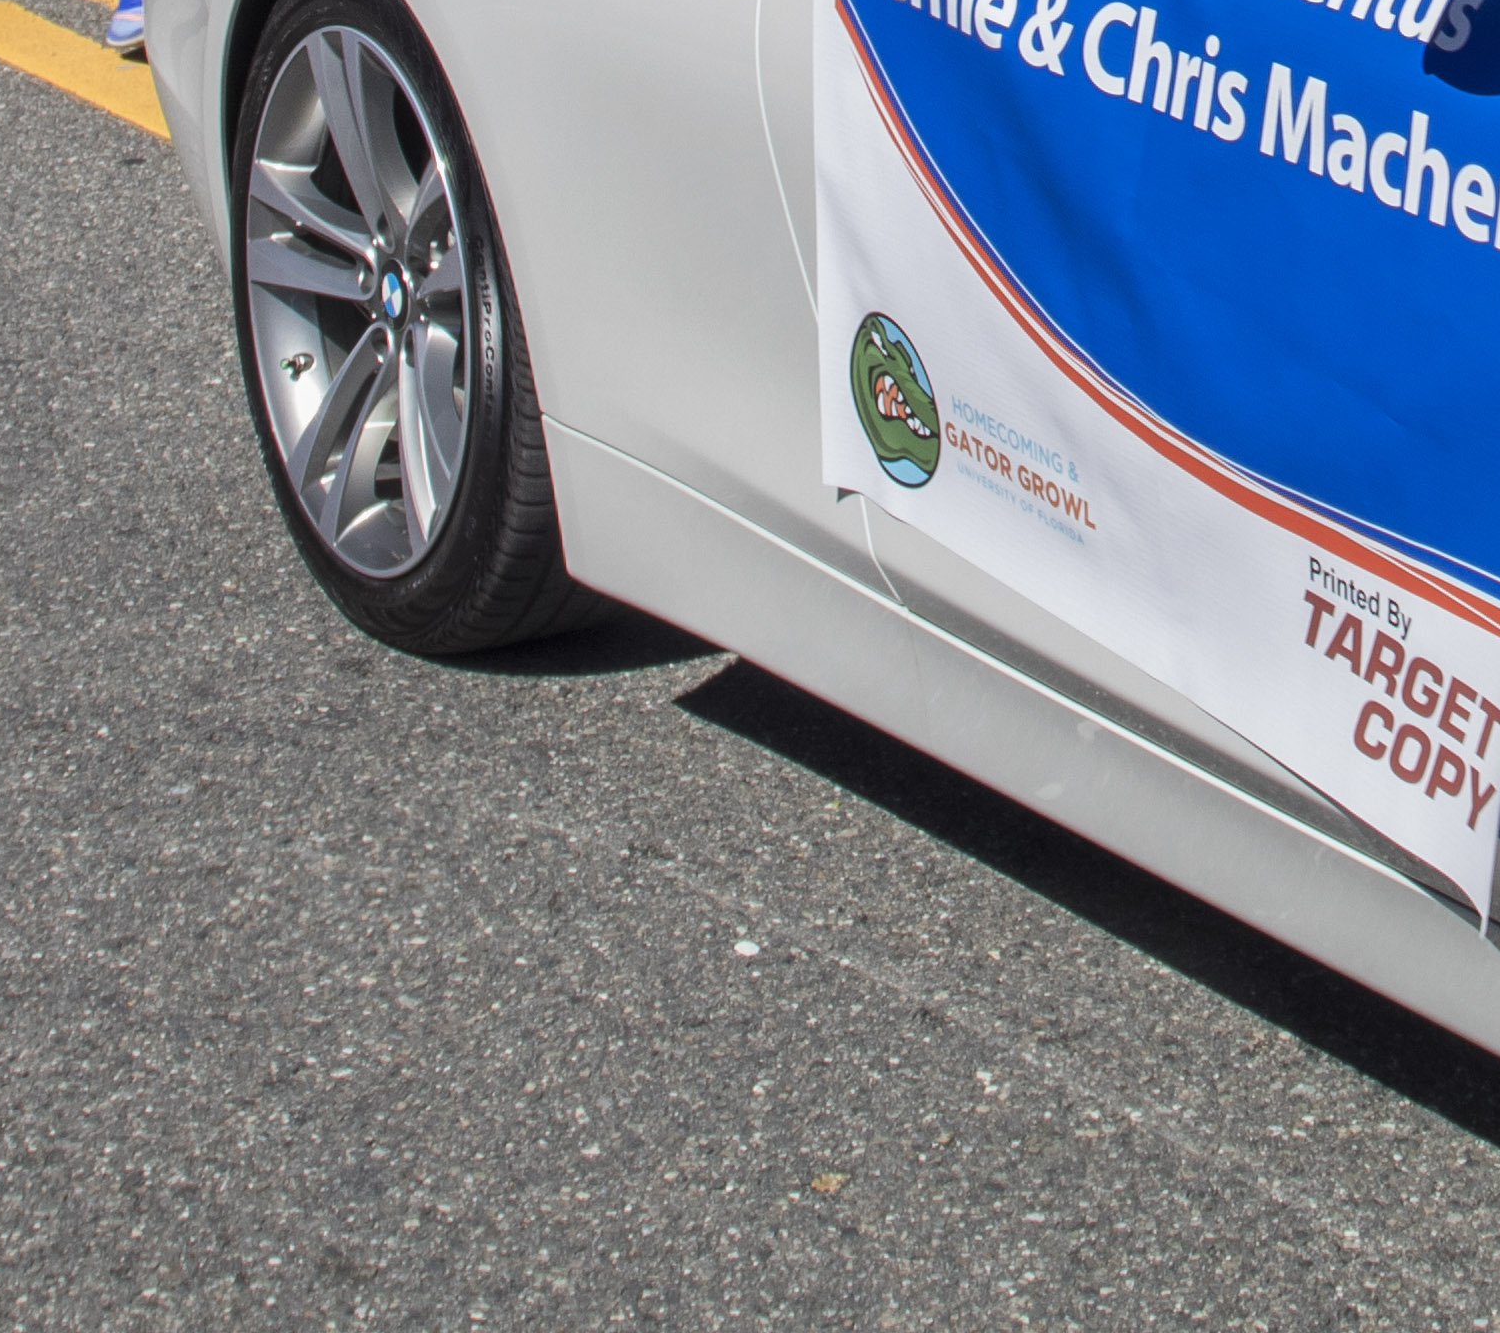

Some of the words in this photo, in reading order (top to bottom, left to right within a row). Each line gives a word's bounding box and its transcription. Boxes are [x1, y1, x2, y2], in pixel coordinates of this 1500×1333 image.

[1082, 1, 1249, 142] Chris
[945, 421, 1013, 482] GATOR
[1017, 464, 1097, 531] GROWL
[951, 394, 1063, 475] HOMECOMING
[1067, 460, 1080, 483] &
[957, 461, 1017, 504] UNIVERSITY
[1019, 498, 1035, 515] OF
[1036, 508, 1086, 547] FLORIDA
[1308, 555, 1380, 617] Printed
[1387, 597, 1413, 641] By
[1353, 699, 1497, 832] COPY
